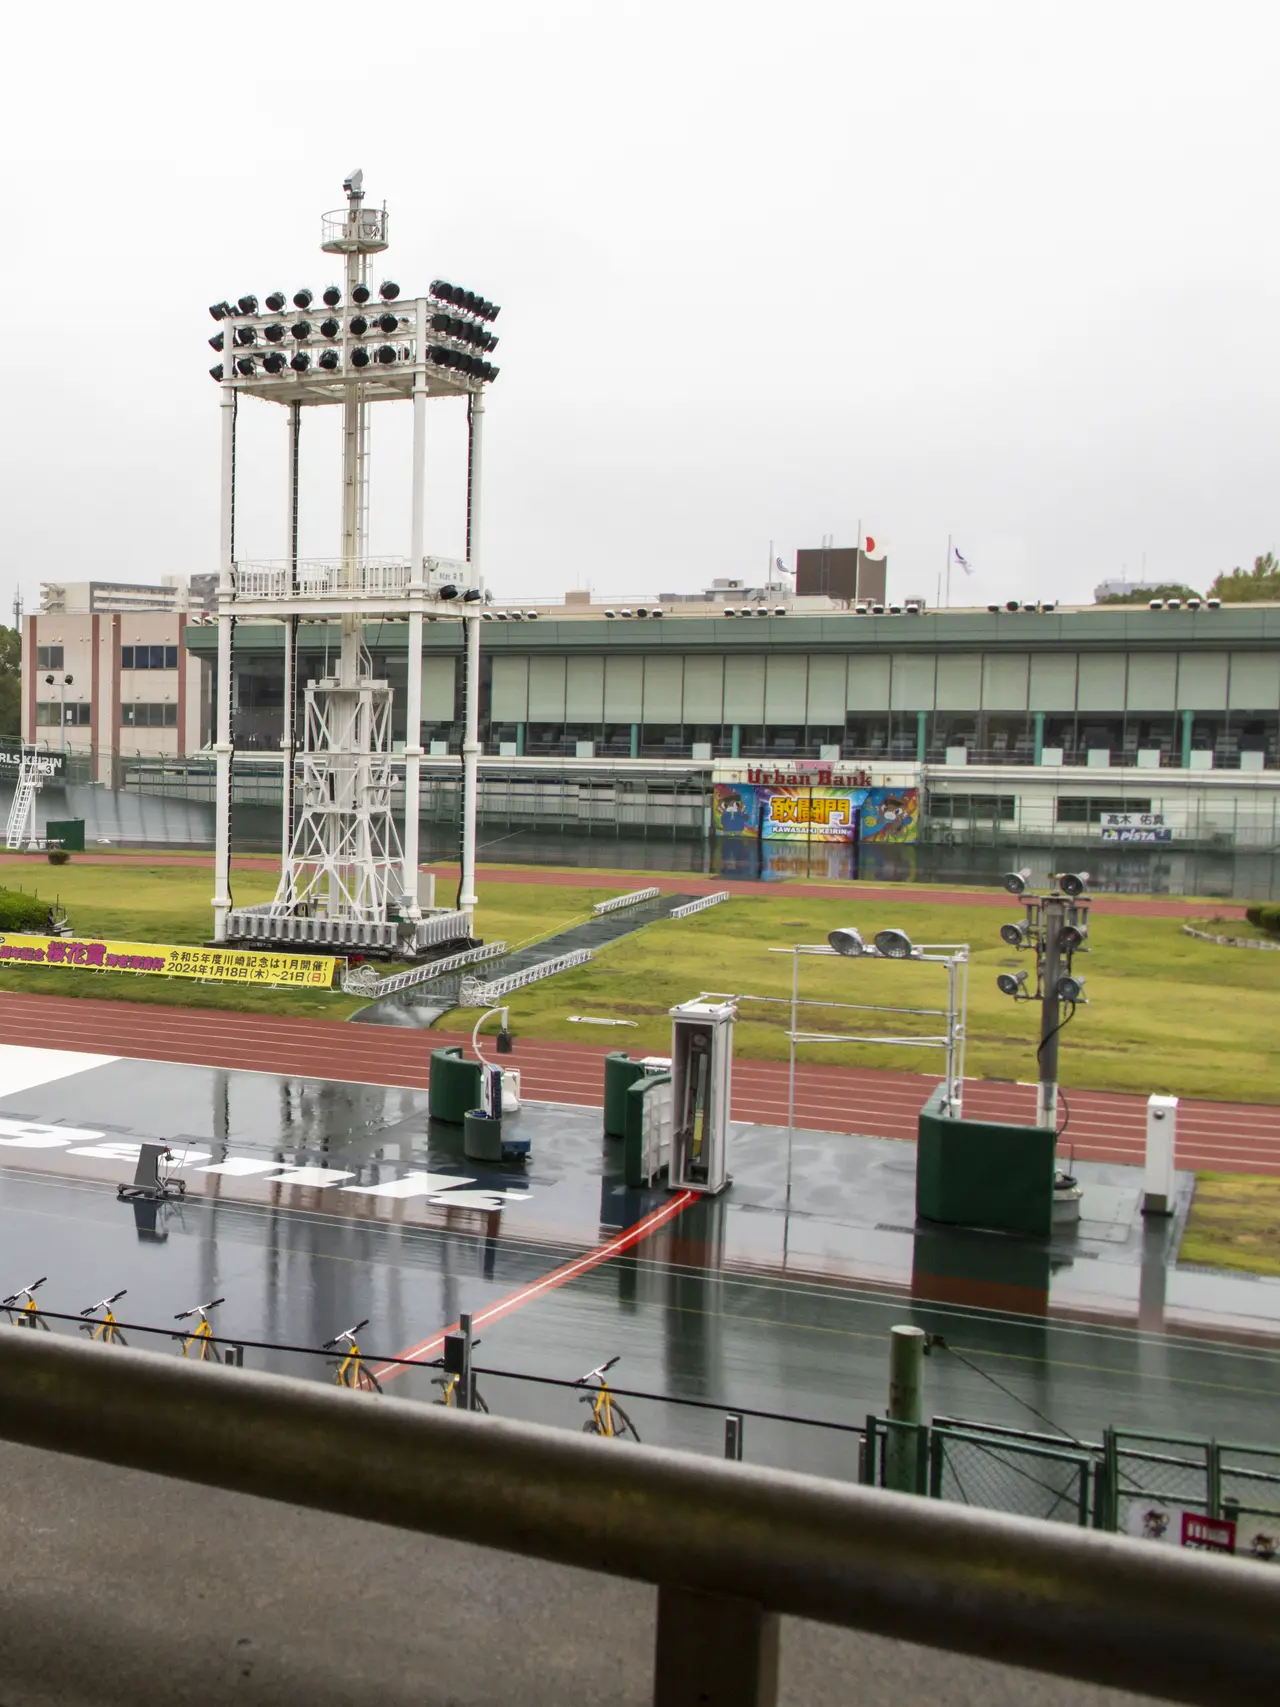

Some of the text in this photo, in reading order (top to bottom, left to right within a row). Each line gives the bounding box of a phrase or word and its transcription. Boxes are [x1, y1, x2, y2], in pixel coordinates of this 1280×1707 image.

[45, 765, 52, 774] 3
[747, 768, 872, 787] Urban Bank
[770, 796, 851, 826] 敢闘門
[772, 826, 818, 835] KAWASAKI
[46, 940, 107, 966] 桜花賞
